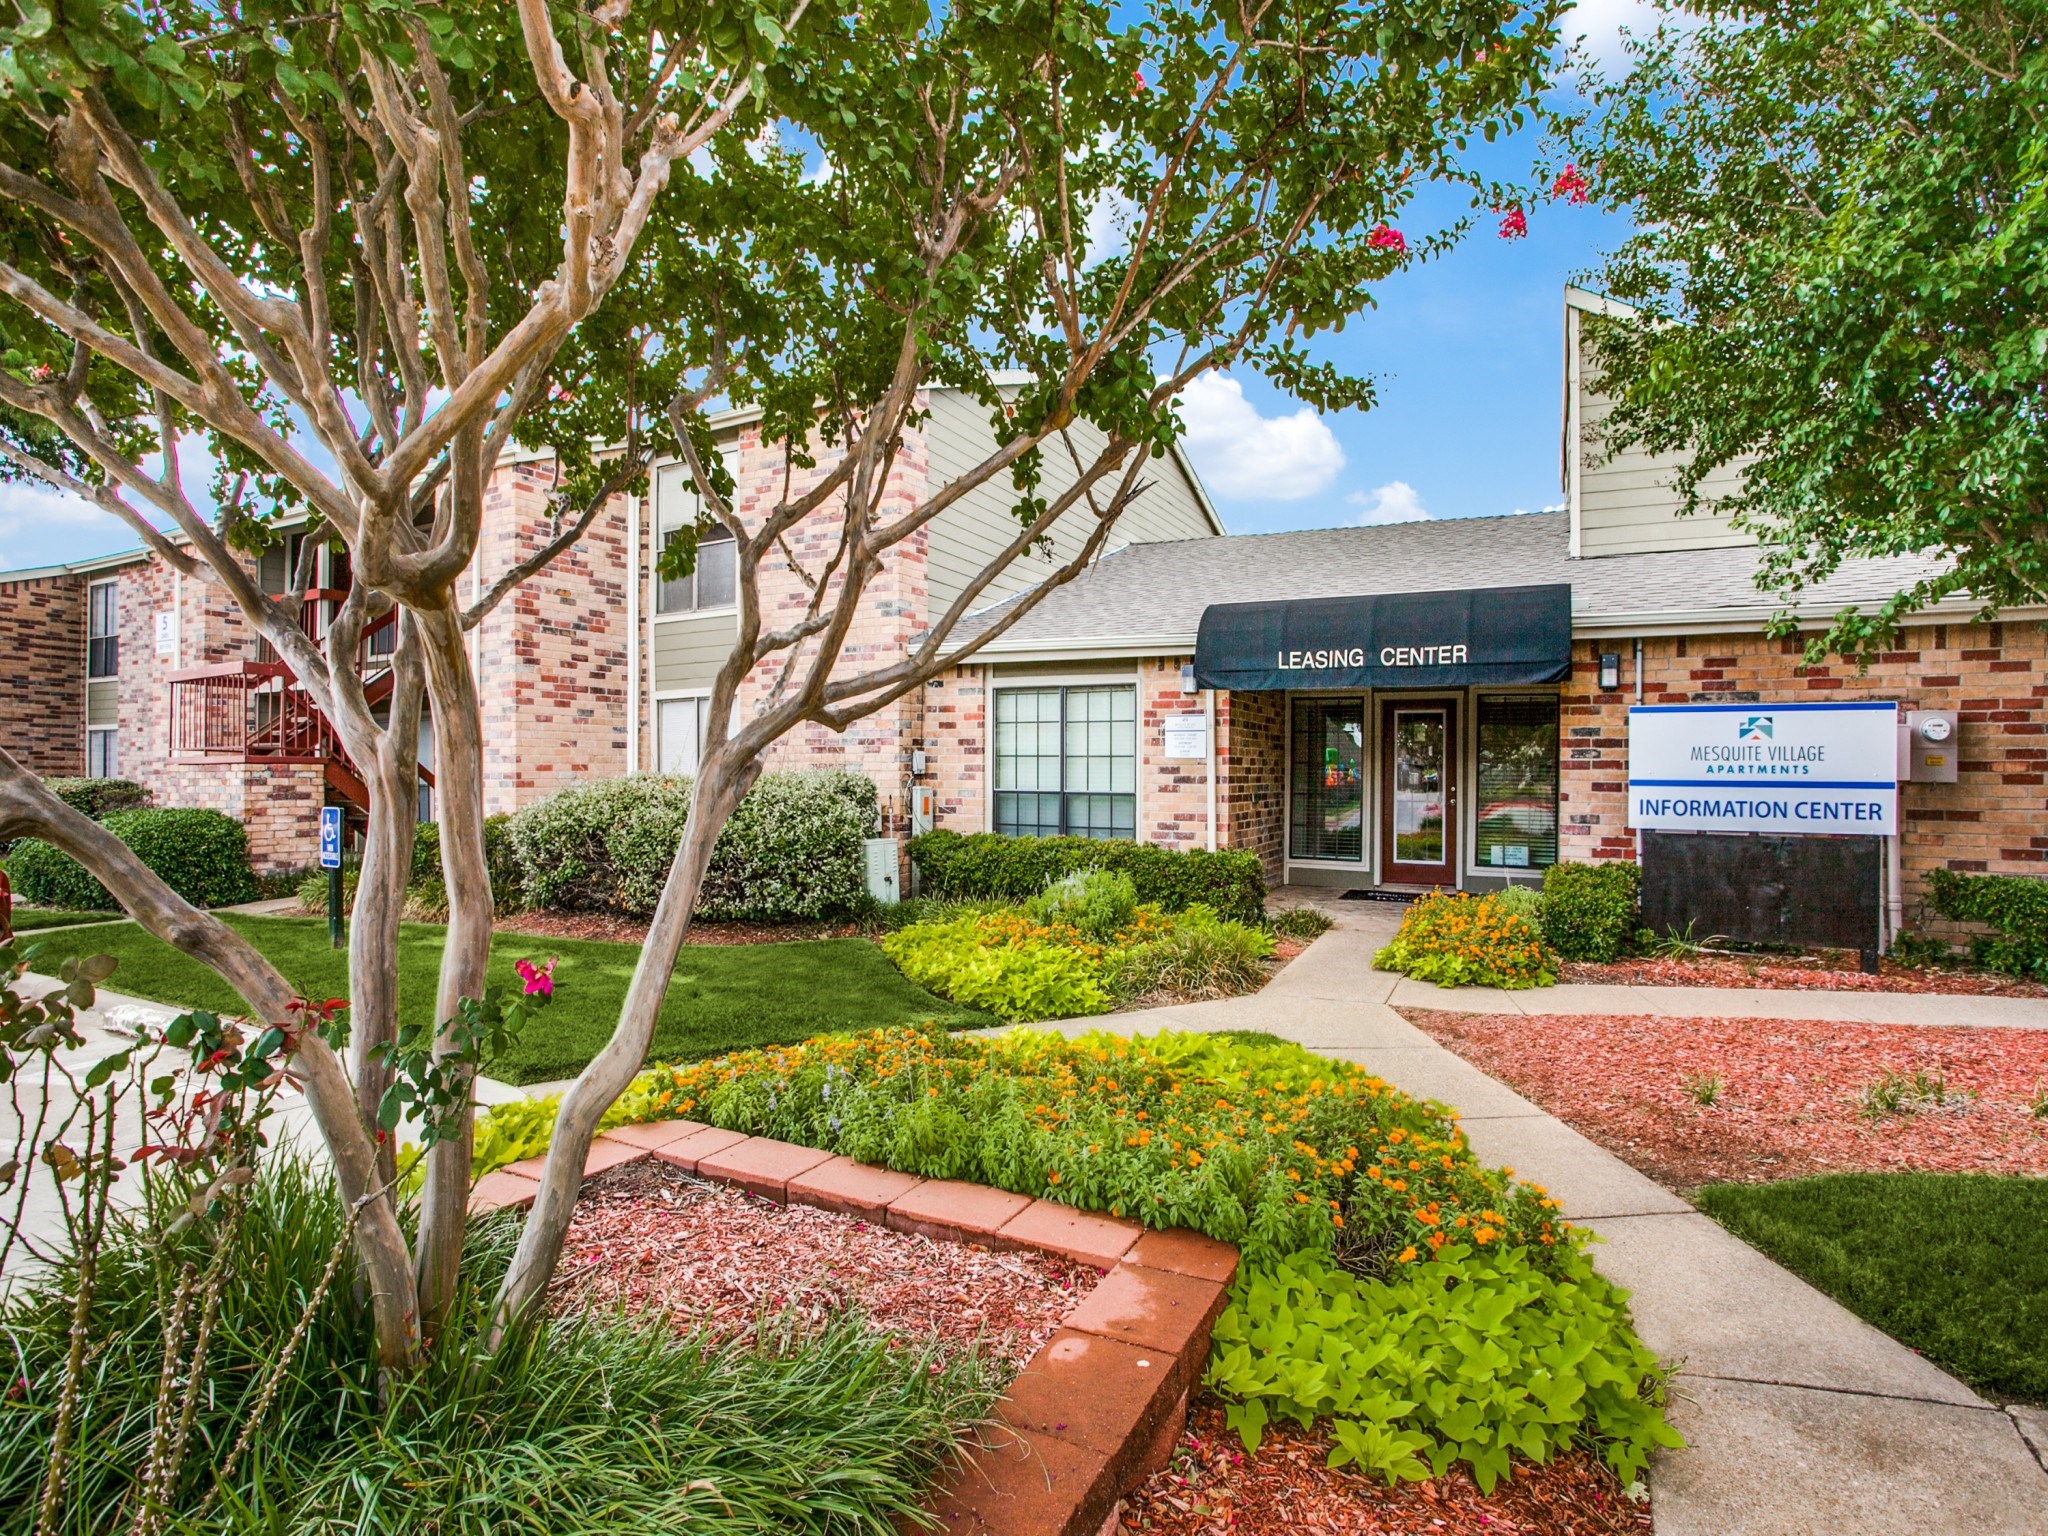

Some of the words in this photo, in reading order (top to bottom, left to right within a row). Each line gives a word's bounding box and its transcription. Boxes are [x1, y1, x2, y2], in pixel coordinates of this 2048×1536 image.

[162, 615, 168, 630] 5
[1278, 648, 1364, 670] LEASING
[1380, 644, 1467, 666] CENTER
[1691, 745, 1762, 762] MESQUITE
[1768, 745, 1825, 762] VILLAGE
[1706, 765, 1809, 775] APARTMENTS
[1639, 799, 1788, 819] INFORMATION
[1795, 801, 1882, 821] CENTER
